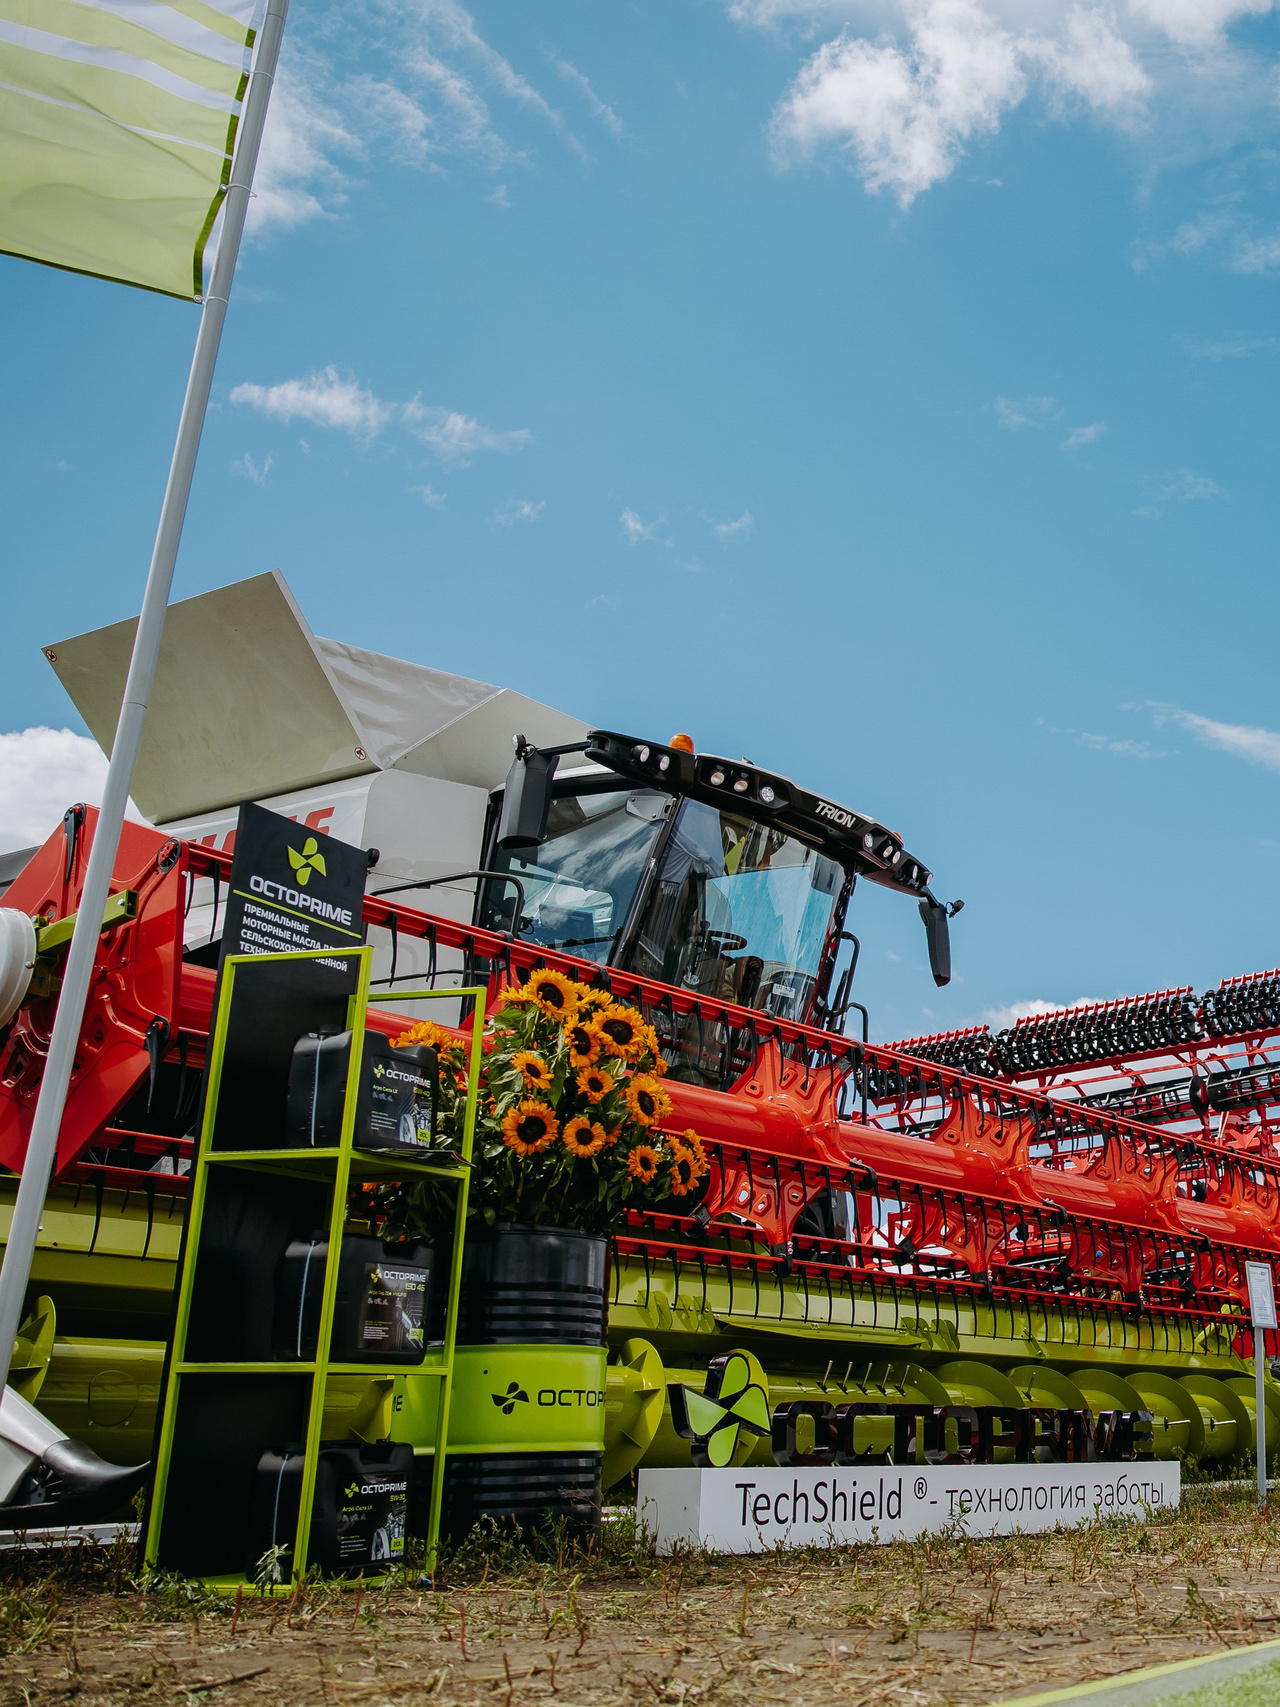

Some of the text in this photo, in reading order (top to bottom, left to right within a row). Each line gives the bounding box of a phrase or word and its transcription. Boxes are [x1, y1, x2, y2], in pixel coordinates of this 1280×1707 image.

[815, 801, 856, 828] TRION
[250, 874, 353, 926] OCTOPRIME
[242, 915, 321, 950] МОТОРНЫЕ МАСЛА
[244, 902, 310, 934] ПРЕМИАЛЬНЫЕ
[386, 1069, 431, 1089] OCTOPRIME
[383, 1270, 427, 1283] OCTOPRIME
[772, 1399, 1156, 1467] OCTOPRIME
[361, 1482, 407, 1494] OCTOPRIME
[735, 1477, 903, 1526] TechShield
[945, 1483, 1087, 1515] технология
[1092, 1473, 1165, 1508] заботы
